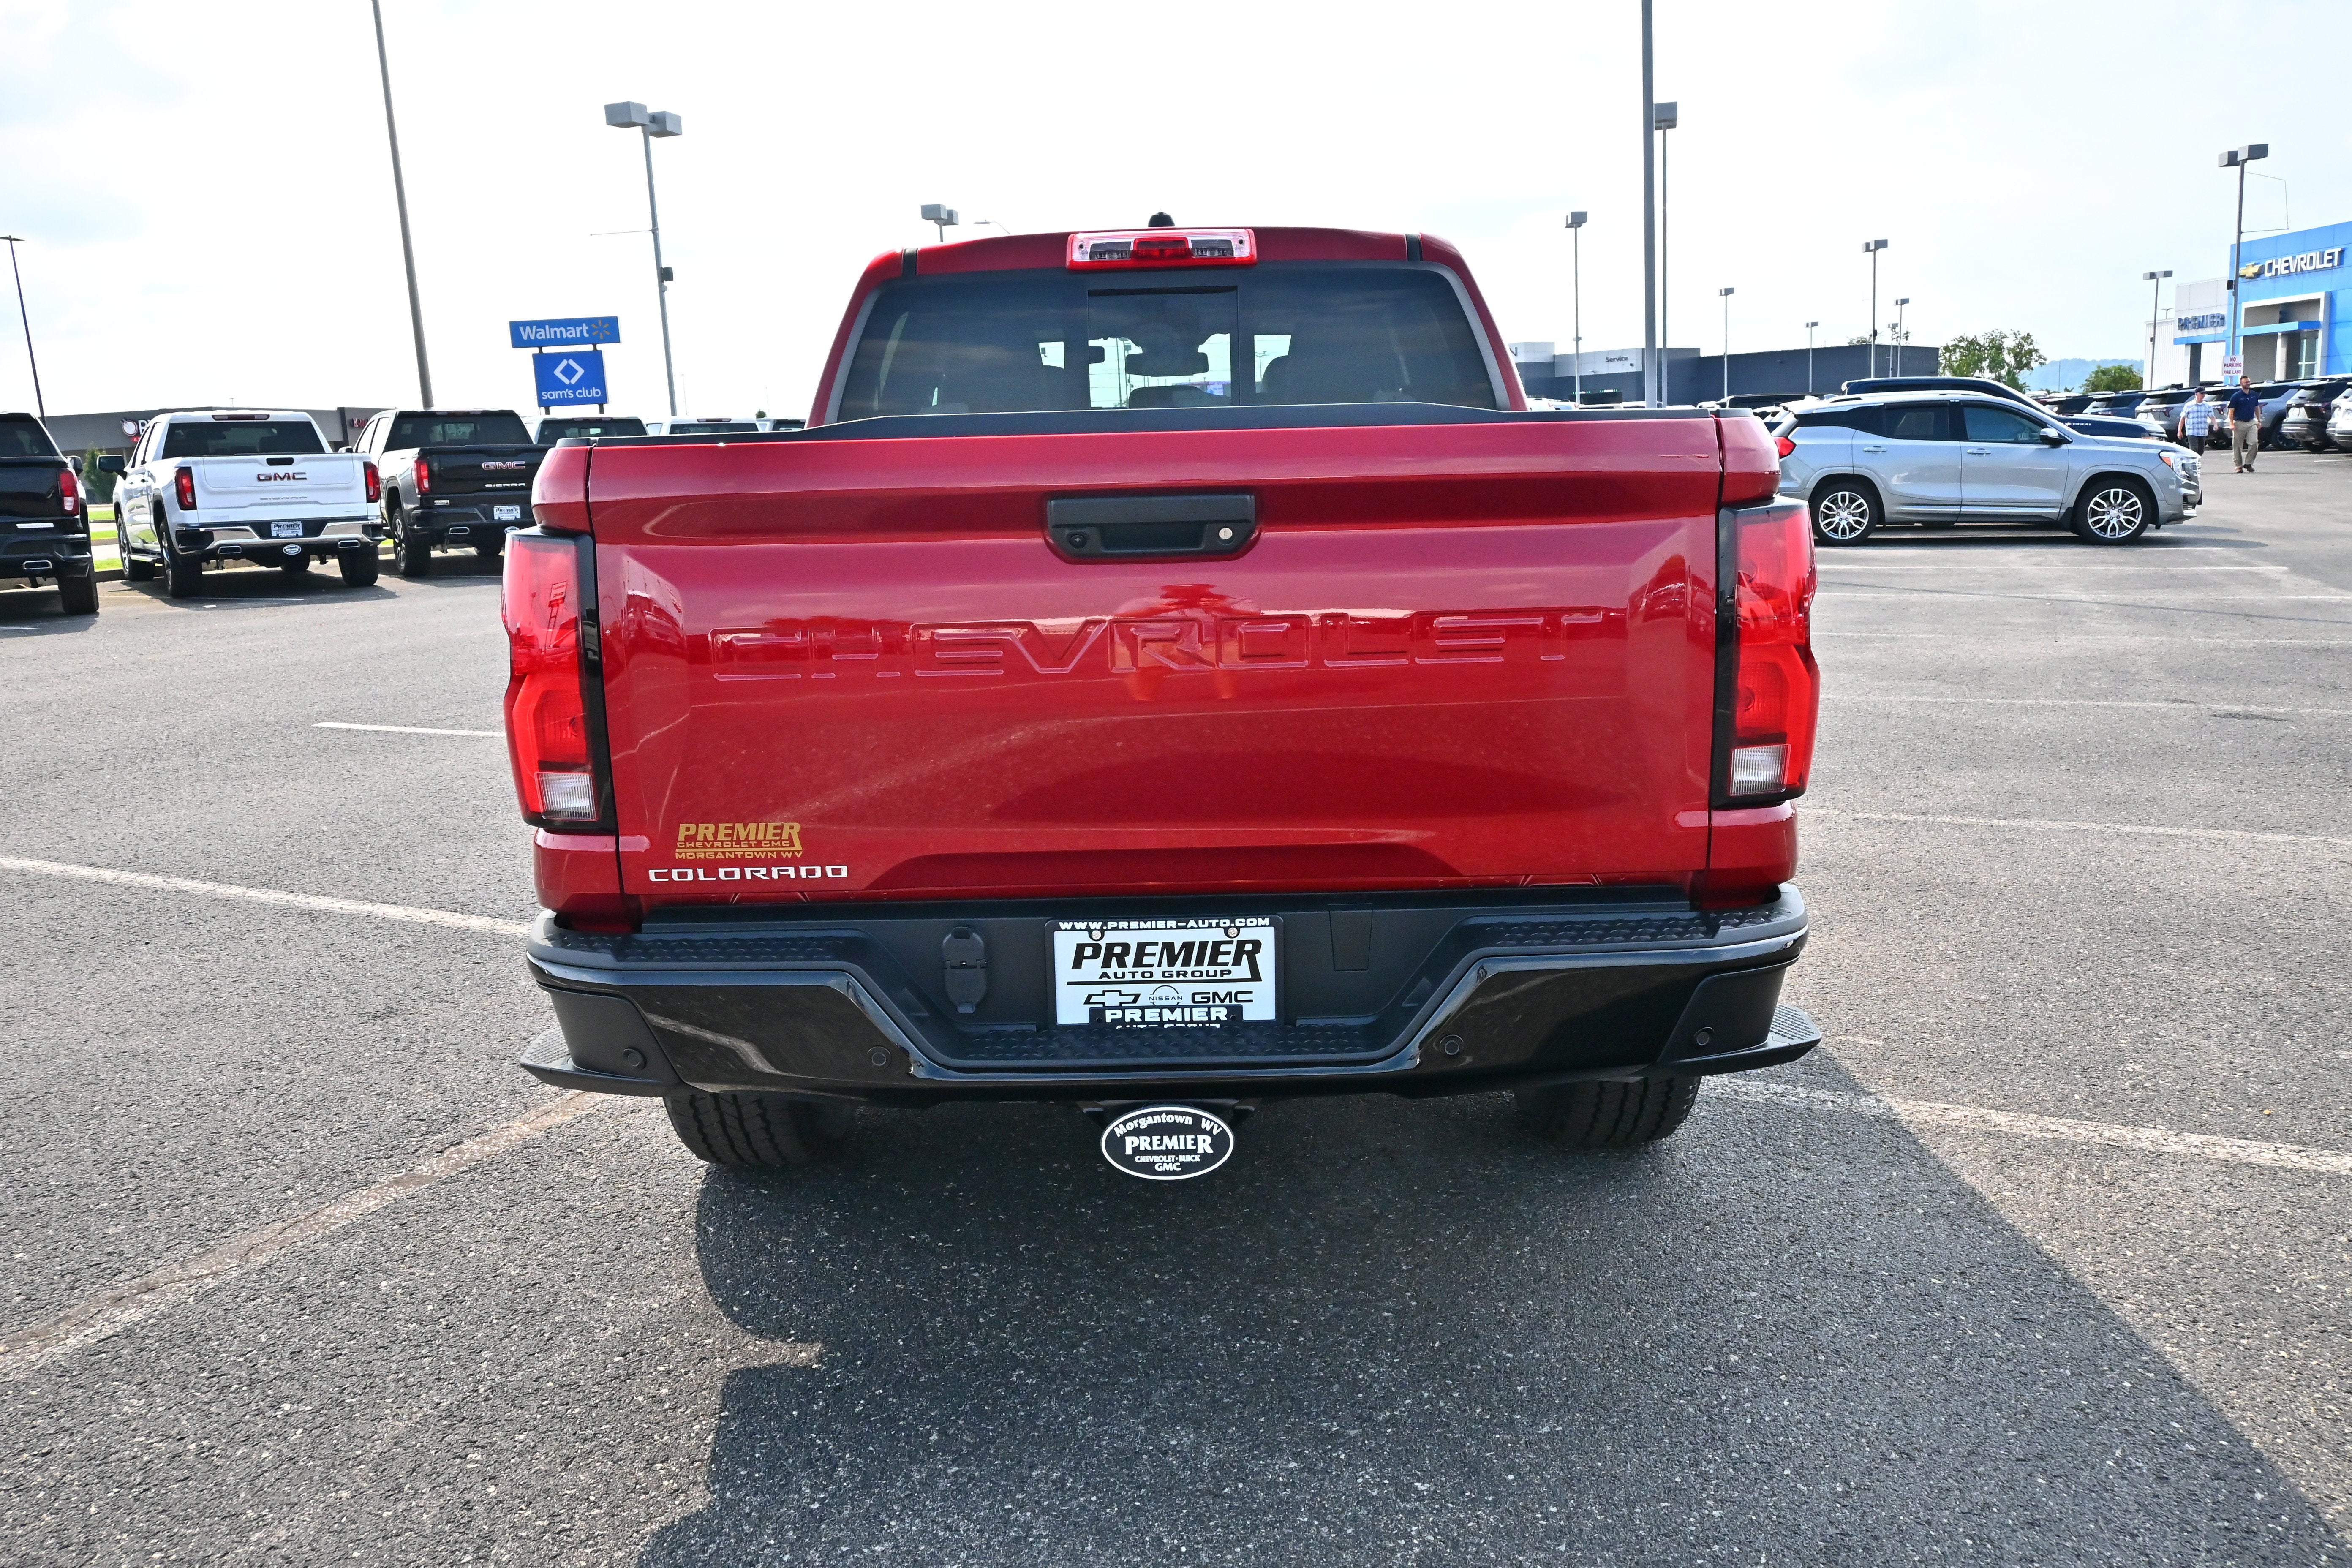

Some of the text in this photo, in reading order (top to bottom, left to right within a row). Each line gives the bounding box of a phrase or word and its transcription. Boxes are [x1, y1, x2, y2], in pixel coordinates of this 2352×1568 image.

[2264, 248, 2342, 277] CHEVROLET
[519, 323, 589, 340] Walmart
[542, 387, 601, 400] sam's club
[482, 461, 525, 470] GMC
[257, 472, 307, 481] GMC
[709, 606, 1605, 681] CHEVROLET
[678, 822, 802, 850] PREMIER
[648, 865, 848, 881] COLORADO
[1059, 917, 1269, 930] WWW.PREMIER-AUTO.COM
[1071, 939, 1262, 981] PREMIER
[1099, 969, 1232, 979] AUTO GROUP
[1191, 991, 1253, 1004] GMC
[1105, 1007, 1228, 1023] PREMIER
[1113, 1113, 1222, 1138] Morgantown WV
[1125, 1135, 1214, 1155] PREMIER
[1154, 1162, 1181, 1171] GMC
